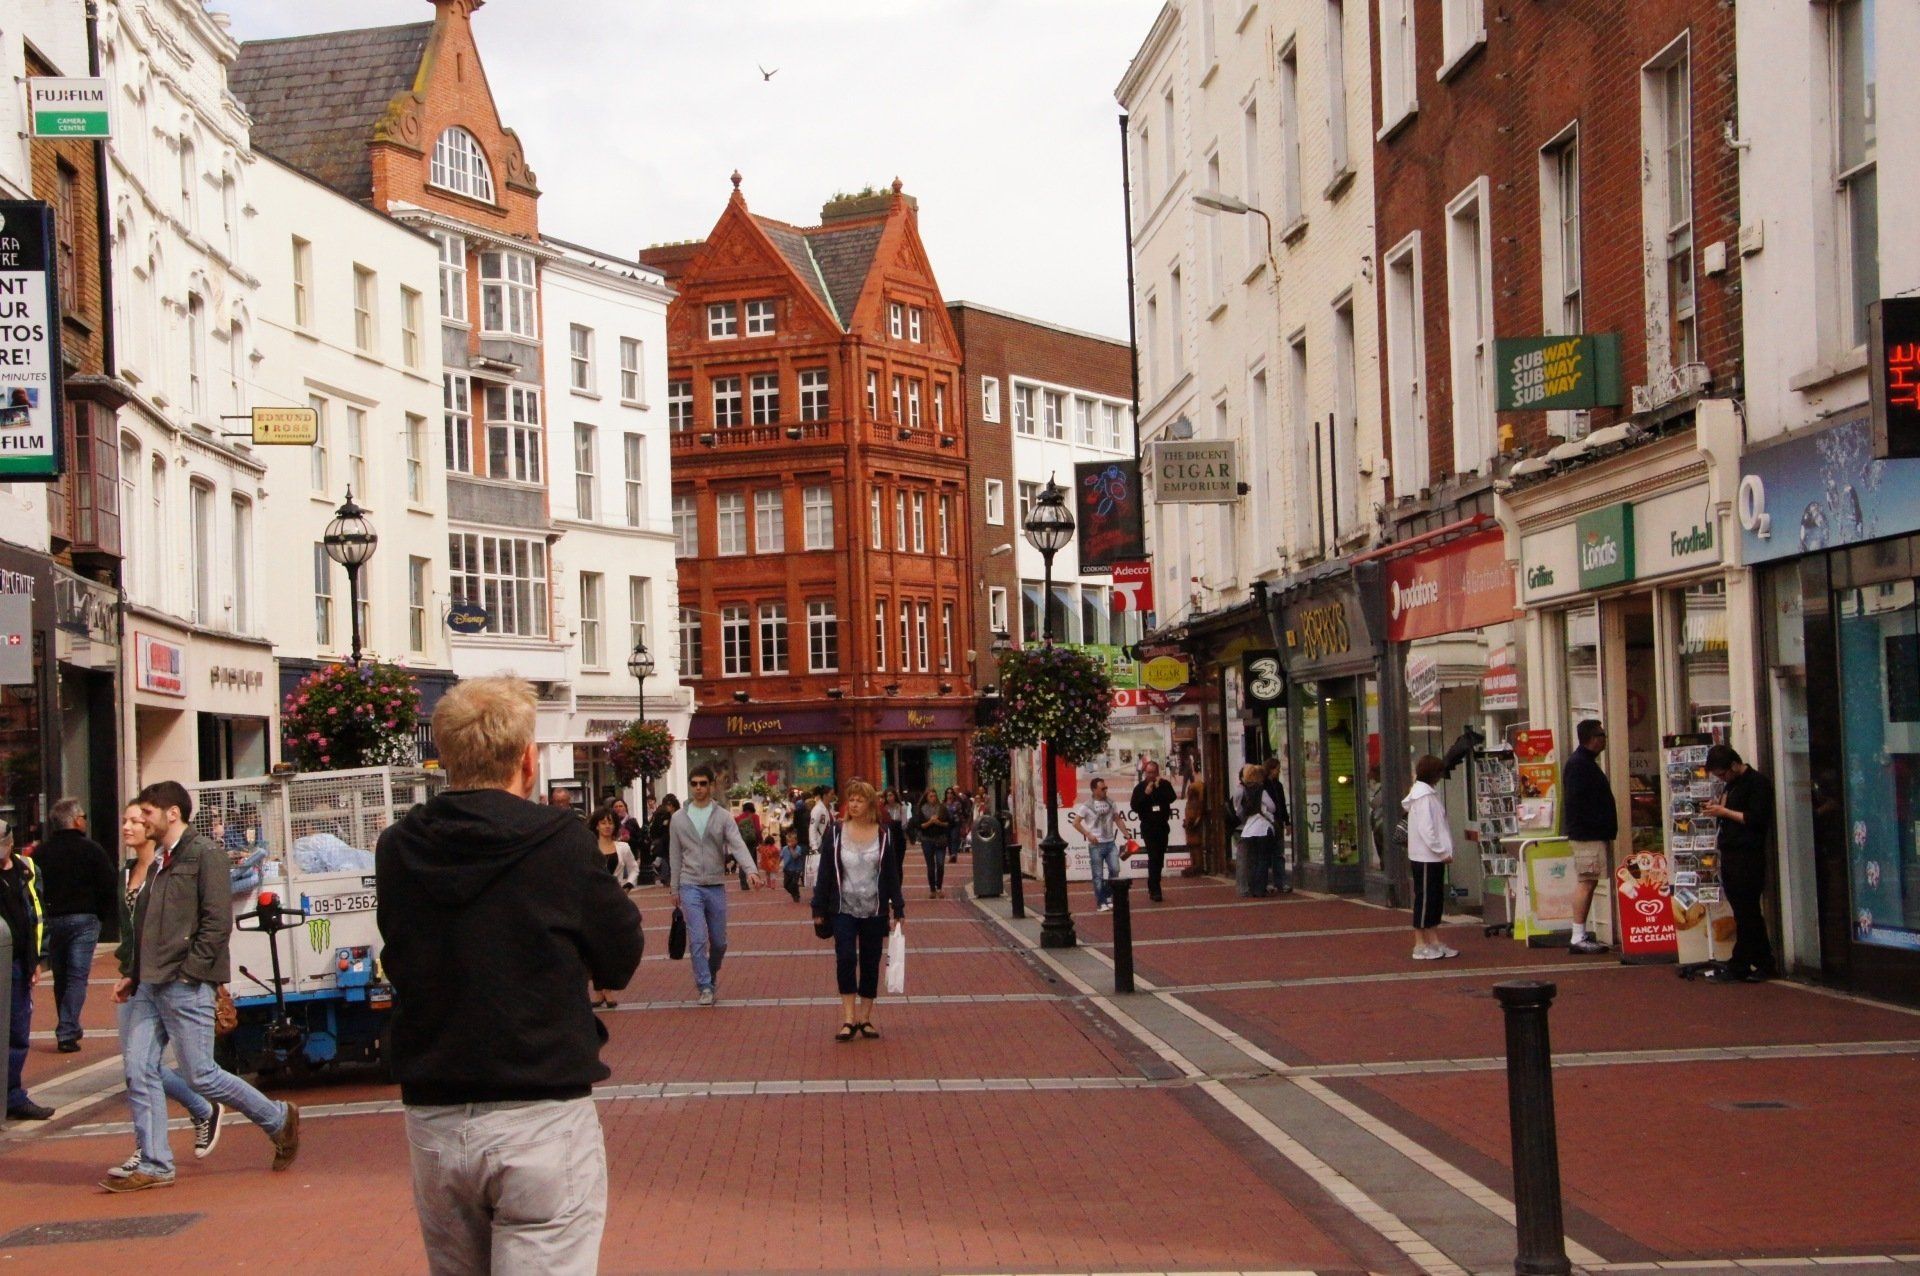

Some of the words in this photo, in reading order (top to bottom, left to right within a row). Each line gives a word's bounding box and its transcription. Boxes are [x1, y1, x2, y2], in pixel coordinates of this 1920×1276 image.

[36, 90, 104, 101] FUJIFILM
[0, 237, 20, 250] RA
[0, 253, 19, 266] RE
[1511, 338, 1582, 374] SUBWAY
[1, 372, 47, 381] MINUTES
[1511, 355, 1582, 391] SUBWAY
[1512, 372, 1582, 407] SUBWAY
[274, 424, 309, 432] ROSS
[1164, 451, 1184, 461] THE
[1186, 450, 1228, 460] DECENT
[1163, 463, 1230, 479] CIGAR
[1164, 481, 1230, 491] EMPORIUM
[1671, 521, 1713, 557] Foodhall
[1583, 535, 1617, 571] Londis
[1114, 566, 1150, 575] Adecco
[1528, 564, 1554, 590] Griffins
[1400, 576, 1439, 610] vodafone
[451, 612, 486, 626] Disney
[1250, 658, 1282, 700] 3
[727, 715, 782, 736] Monsoon
[315, 895, 378, 913] 09-D-2562
[1630, 925, 1660, 934] FANCY
[1662, 924, 1674, 933] AN
[1630, 935, 1643, 943] ICE
[1644, 933, 1676, 942] CREAM?
